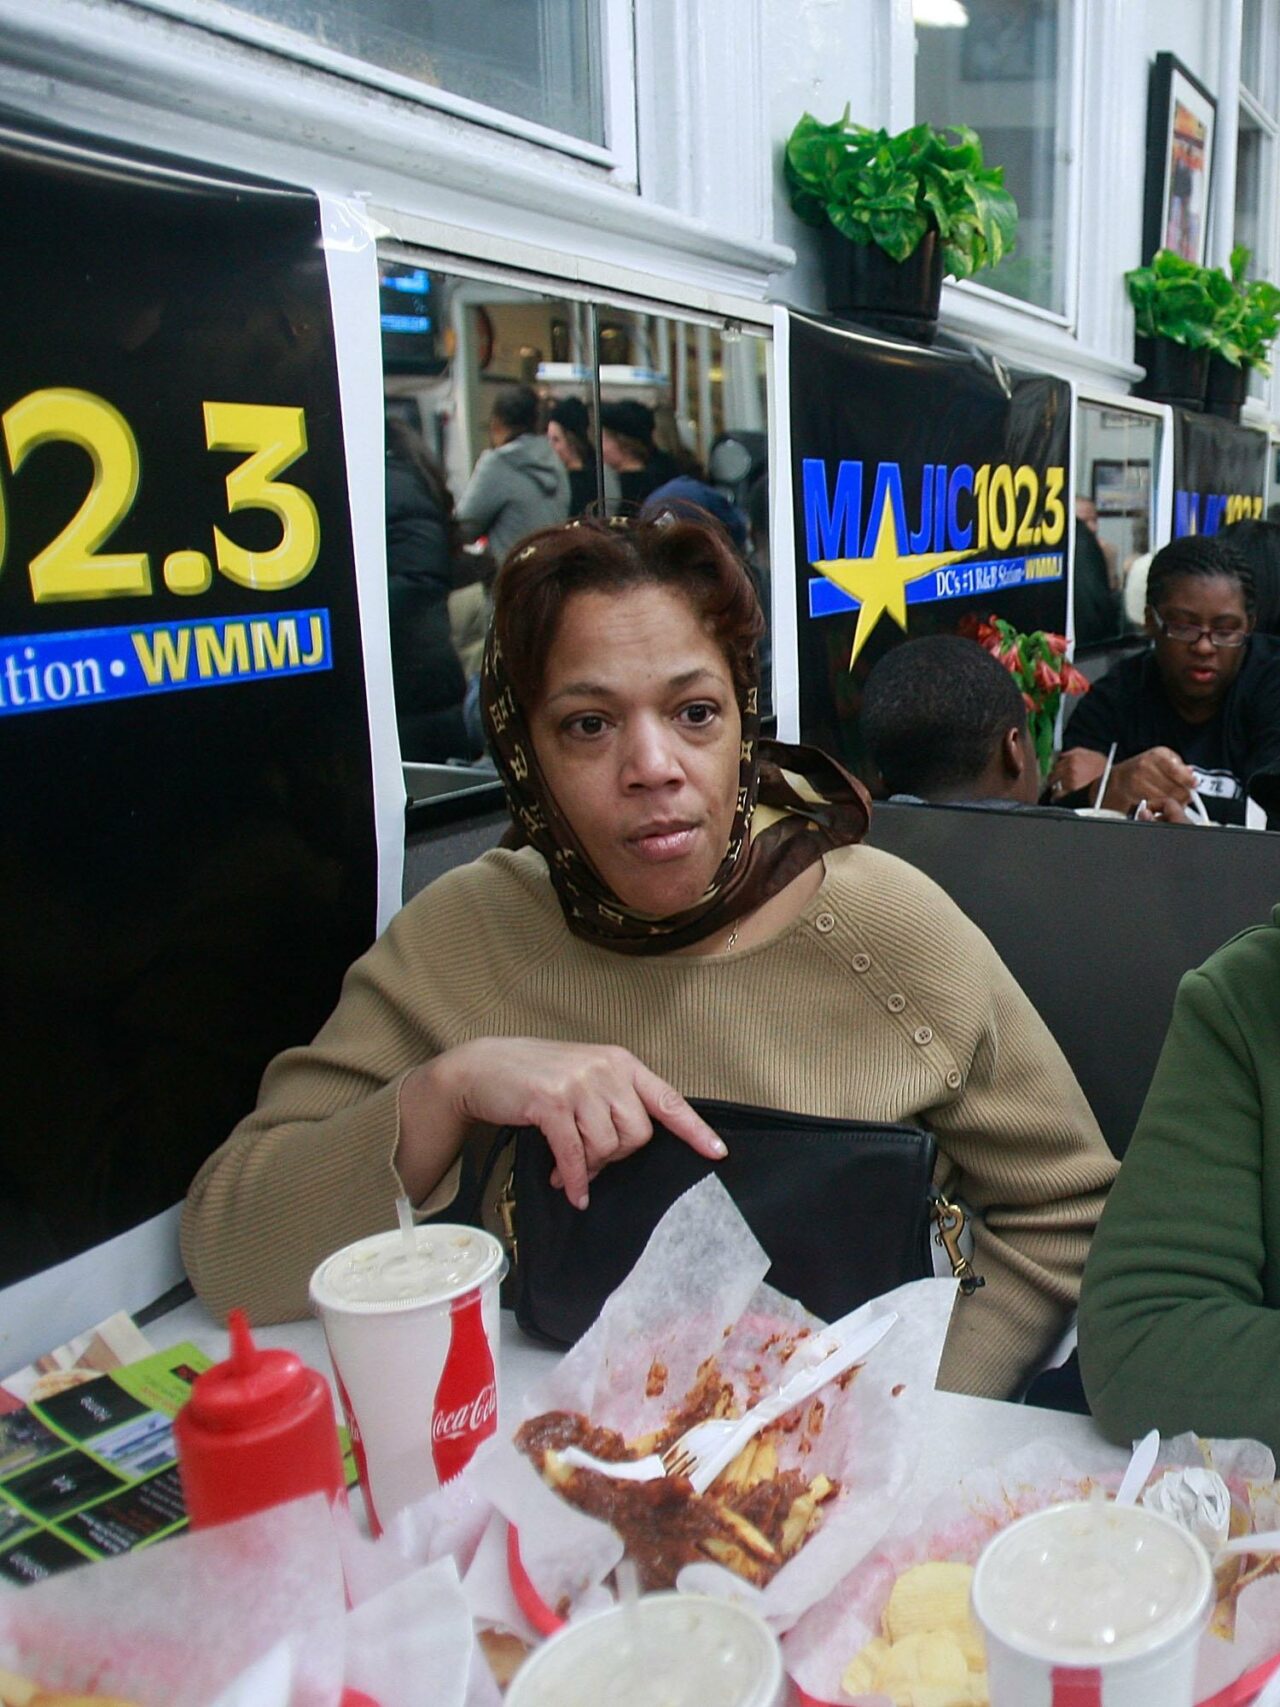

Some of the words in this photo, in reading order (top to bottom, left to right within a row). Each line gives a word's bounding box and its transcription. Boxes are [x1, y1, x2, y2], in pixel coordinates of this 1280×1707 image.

[0, 387, 321, 603] 2.3
[936, 569, 961, 597] DC's
[0, 647, 105, 708] tion
[131, 616, 324, 687] WMMJ
